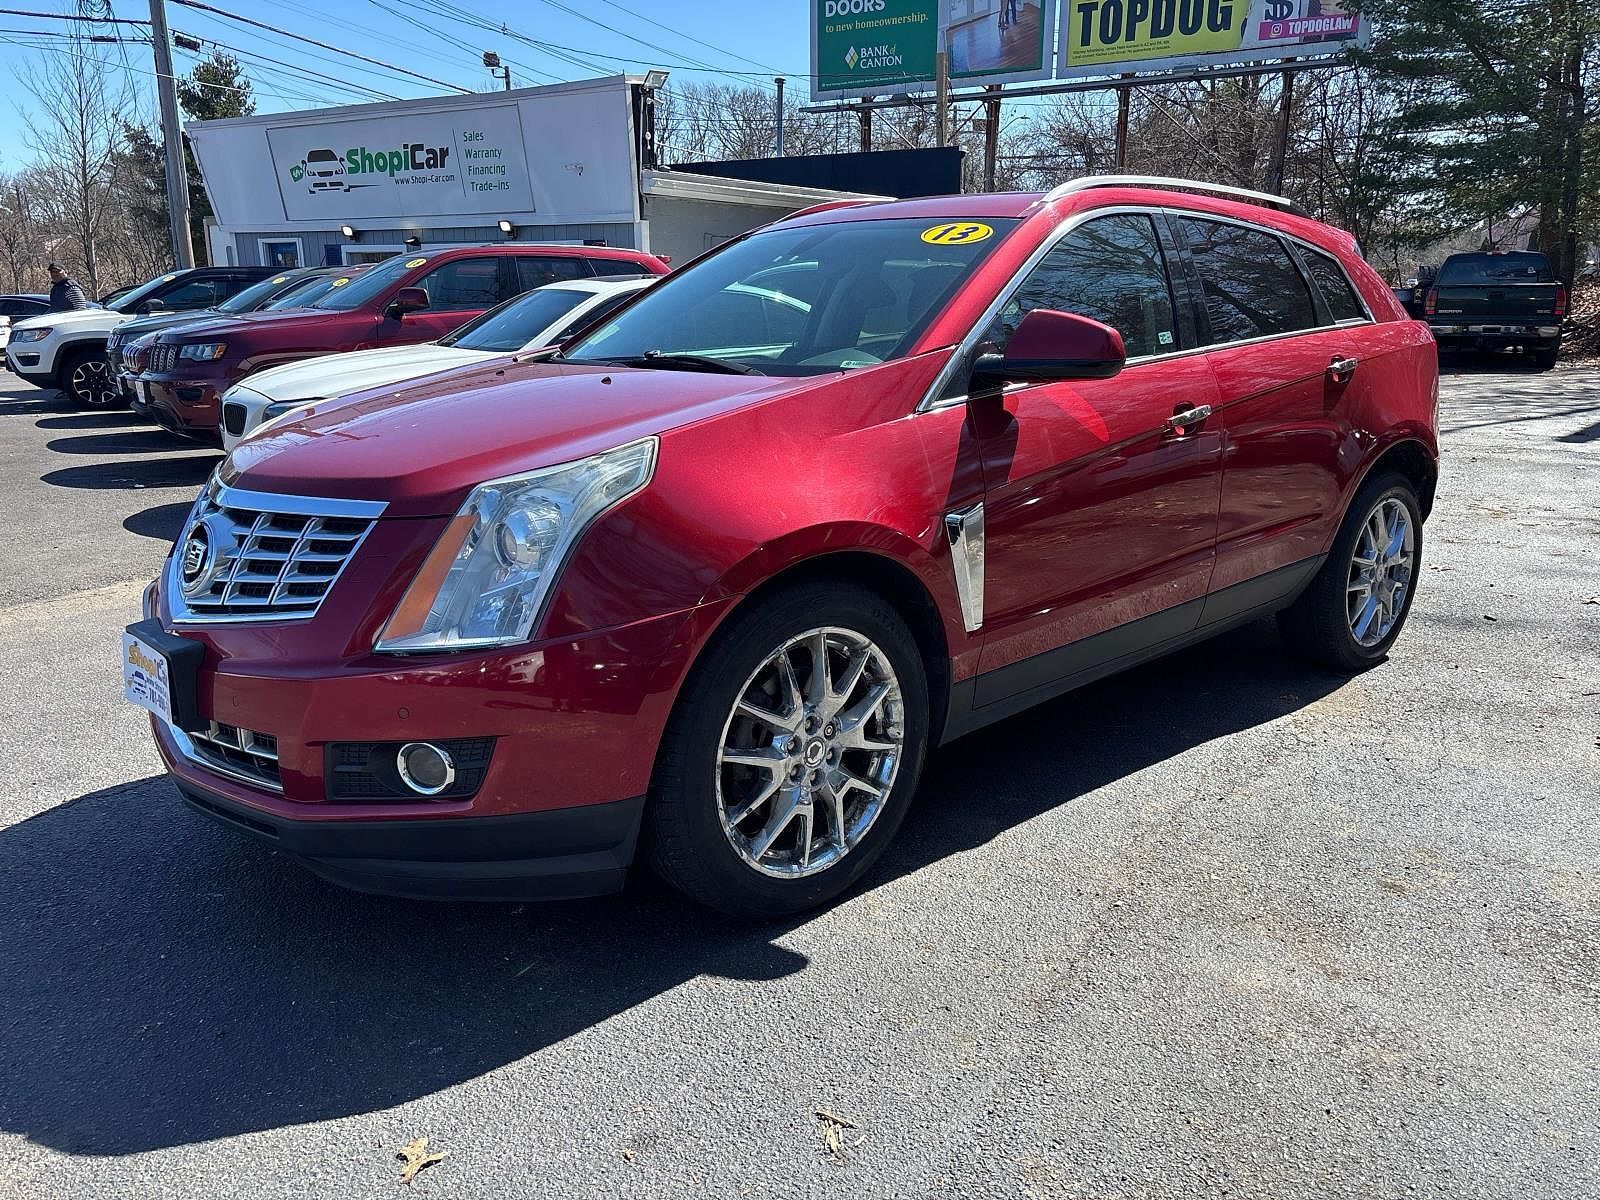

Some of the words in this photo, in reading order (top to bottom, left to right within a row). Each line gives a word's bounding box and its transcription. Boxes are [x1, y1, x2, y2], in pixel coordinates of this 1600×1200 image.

[825, 0, 885, 17] DOORS
[826, 24, 834, 33] to
[836, 22, 855, 32] new
[855, 12, 929, 30] homeownership.
[1078, 0, 1233, 46] TOPDOG
[1288, 16, 1354, 34] TOPDOGLAW
[861, 45, 889, 58] BANK
[889, 43, 897, 55] of
[860, 55, 902, 69] CANTON
[463, 131, 484, 142] Sales
[346, 144, 449, 177] ShopiCar
[464, 148, 503, 160] Warranty
[468, 164, 506, 177] Financing
[470, 181, 510, 192] Trade-ins
[932, 226, 980, 241] 13
